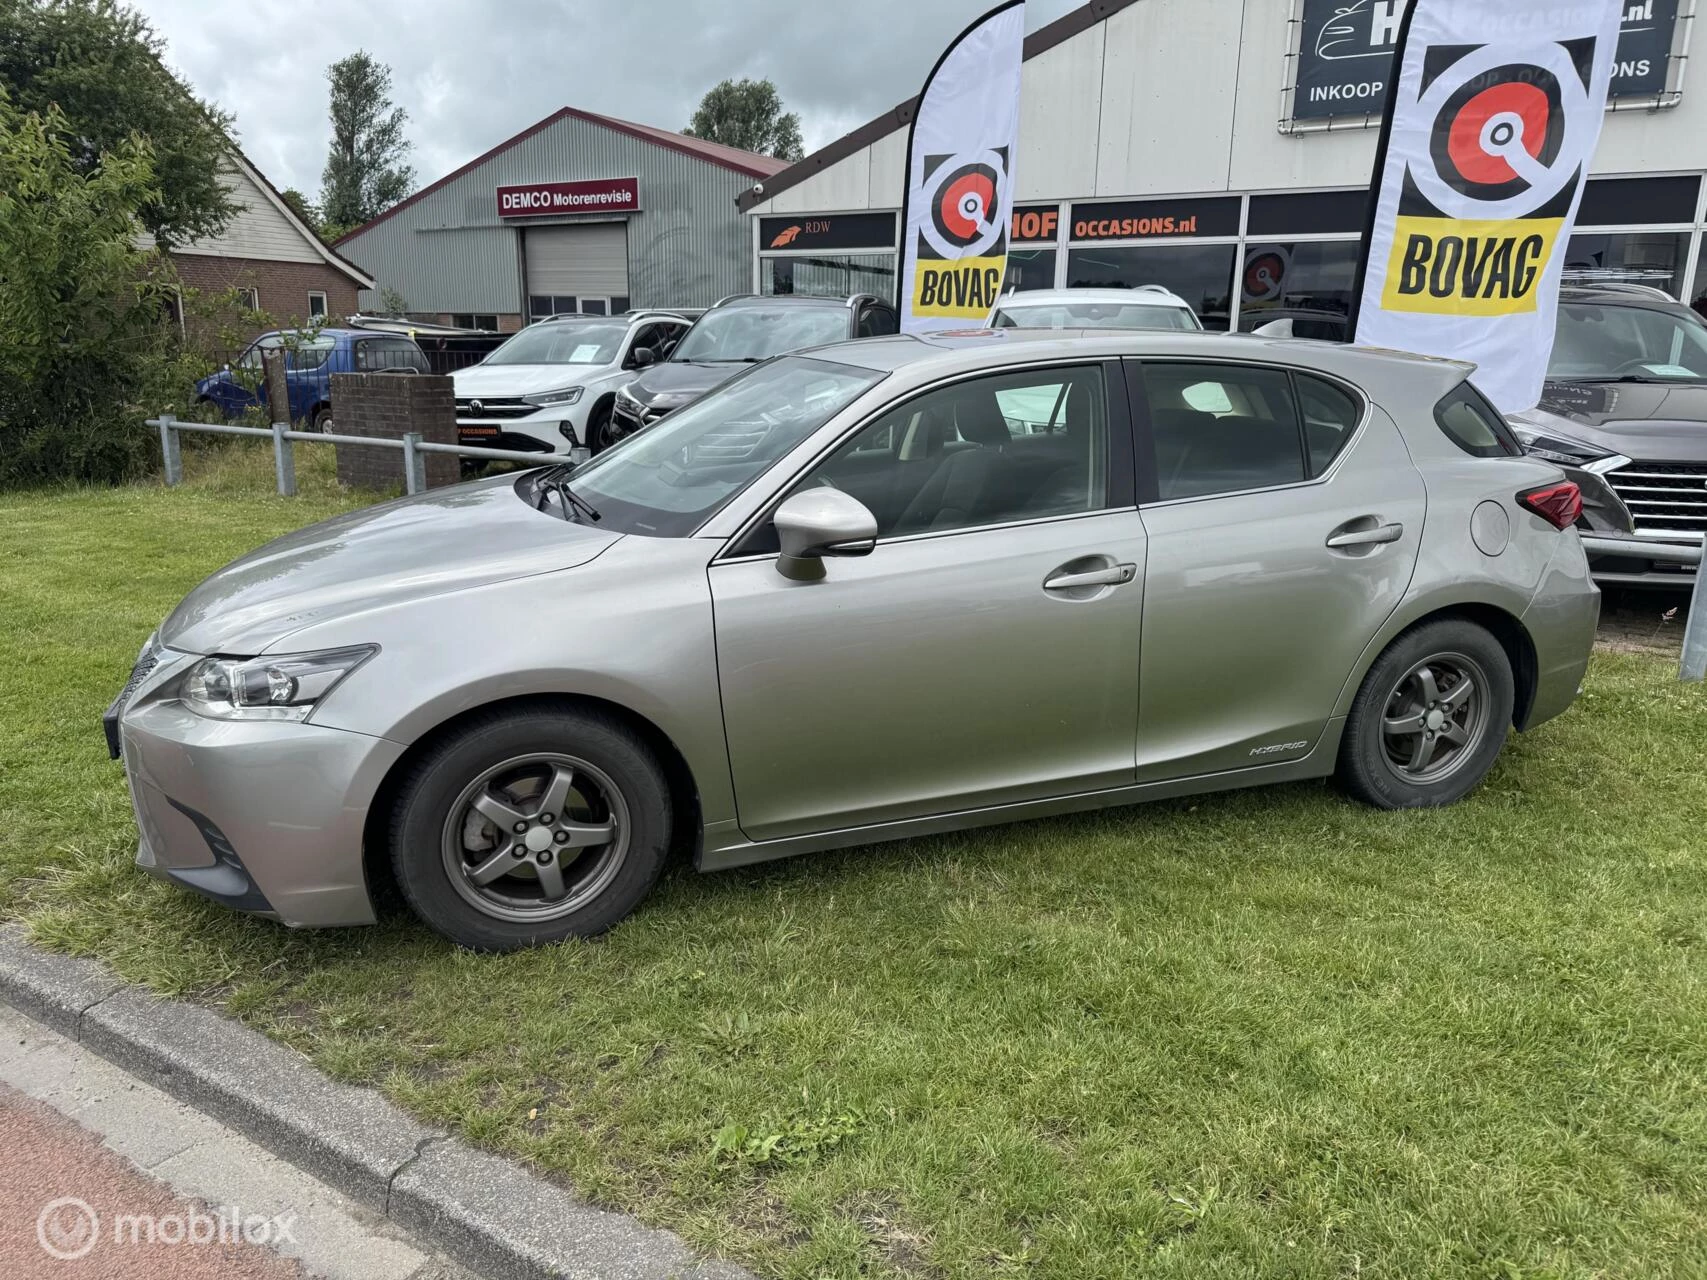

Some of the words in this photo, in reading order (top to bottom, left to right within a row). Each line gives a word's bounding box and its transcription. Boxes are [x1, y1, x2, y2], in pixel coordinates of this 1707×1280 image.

[1309, 81, 1384, 102] INKOOP
[502, 191, 551, 209] DEMCO
[553, 189, 632, 207] Motorenrevisie
[805, 220, 831, 234] RDW
[1074, 215, 1197, 238] OCCASIONS.nl
[1397, 233, 1544, 299] BOVAG
[919, 267, 1000, 309] BOVAG
